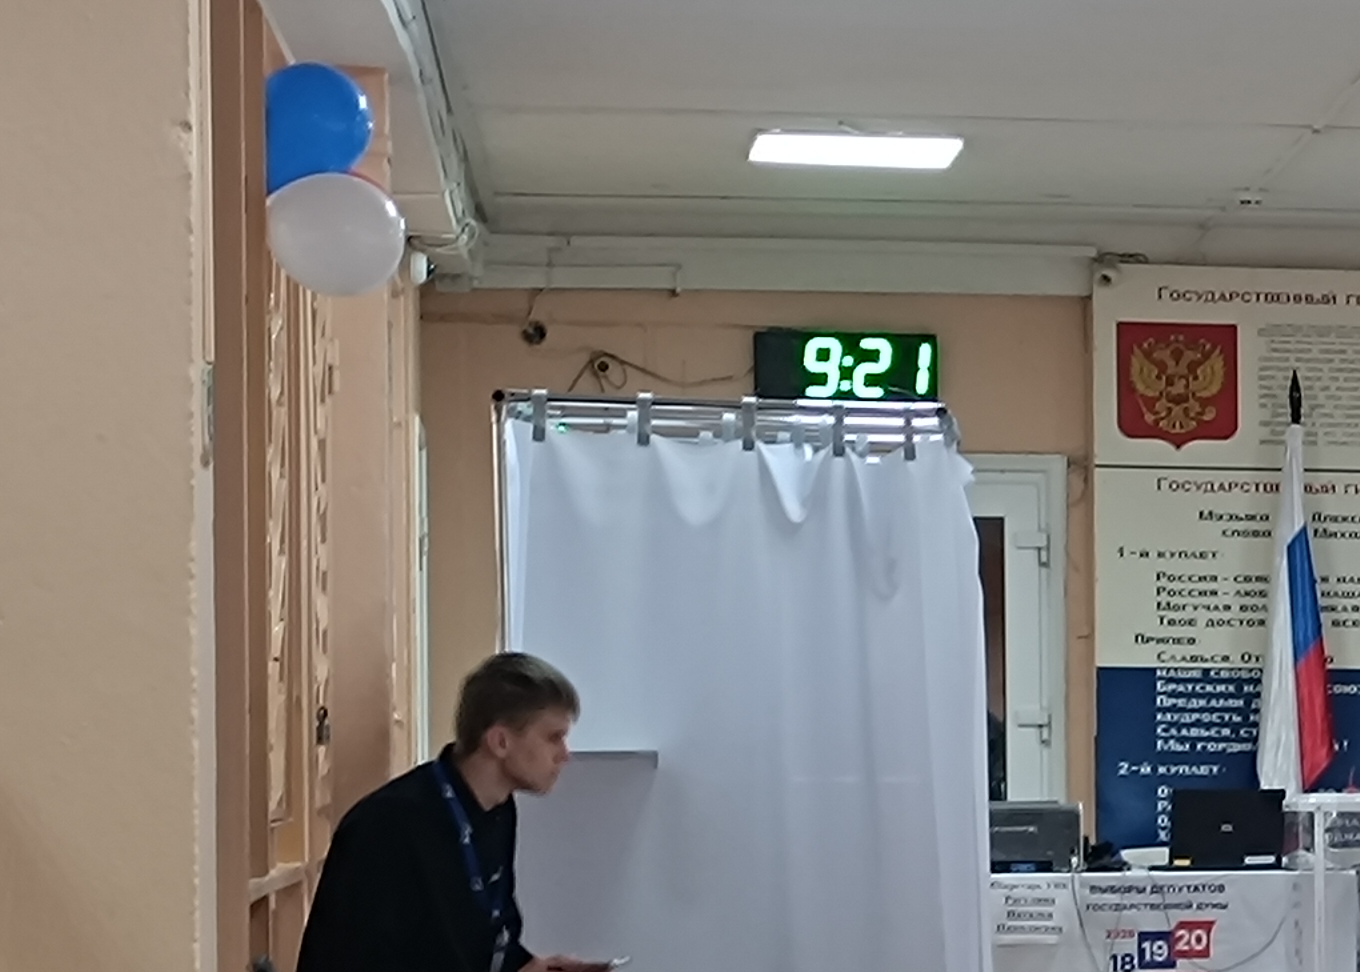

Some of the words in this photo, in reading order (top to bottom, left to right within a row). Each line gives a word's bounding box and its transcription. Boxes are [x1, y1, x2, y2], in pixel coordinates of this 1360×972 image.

[803, 336, 932, 398] 9:21
[1149, 882, 1226, 895] ДЕПУТАТОВ
[1141, 940, 1169, 962] 19
[1175, 929, 1208, 951] 20
